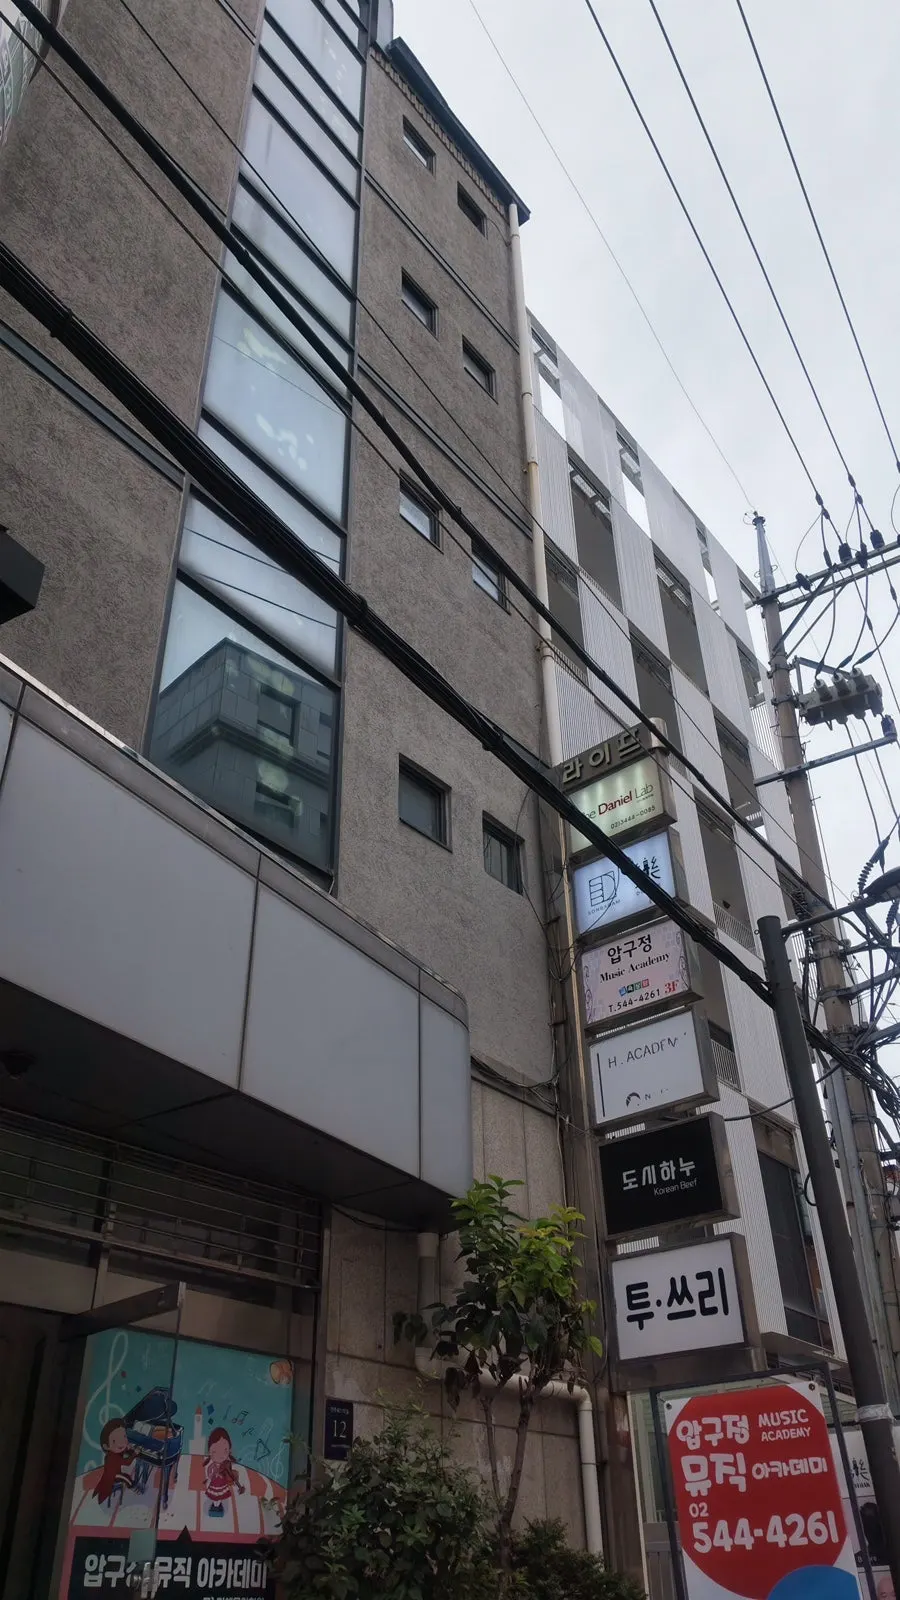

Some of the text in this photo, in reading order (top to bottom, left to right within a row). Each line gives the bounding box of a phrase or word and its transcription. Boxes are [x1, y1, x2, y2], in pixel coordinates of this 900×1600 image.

[598, 791, 633, 816] Daniel
[634, 783, 654, 799] Lab
[607, 934, 652, 965] 압구정
[600, 953, 670, 984] Music Academy
[608, 989, 661, 1013] T.544-4261
[664, 980, 679, 994] 3F
[622, 1157, 696, 1191] 도시하누
[654, 1178, 698, 1196] Korean Beef
[333, 1420, 347, 1438] 12
[676, 1415, 750, 1450] 압구정
[758, 1409, 809, 1429] MUSIC
[761, 1427, 811, 1442] ACADEMY
[681, 1452, 747, 1497] 뮤직
[752, 1457, 828, 1480] 아카데미
[689, 1502, 709, 1518] 02
[692, 1510, 840, 1554] 544-4261
[83, 1554, 144, 1589] 압구
[197, 1558, 268, 1590] 아카데미
